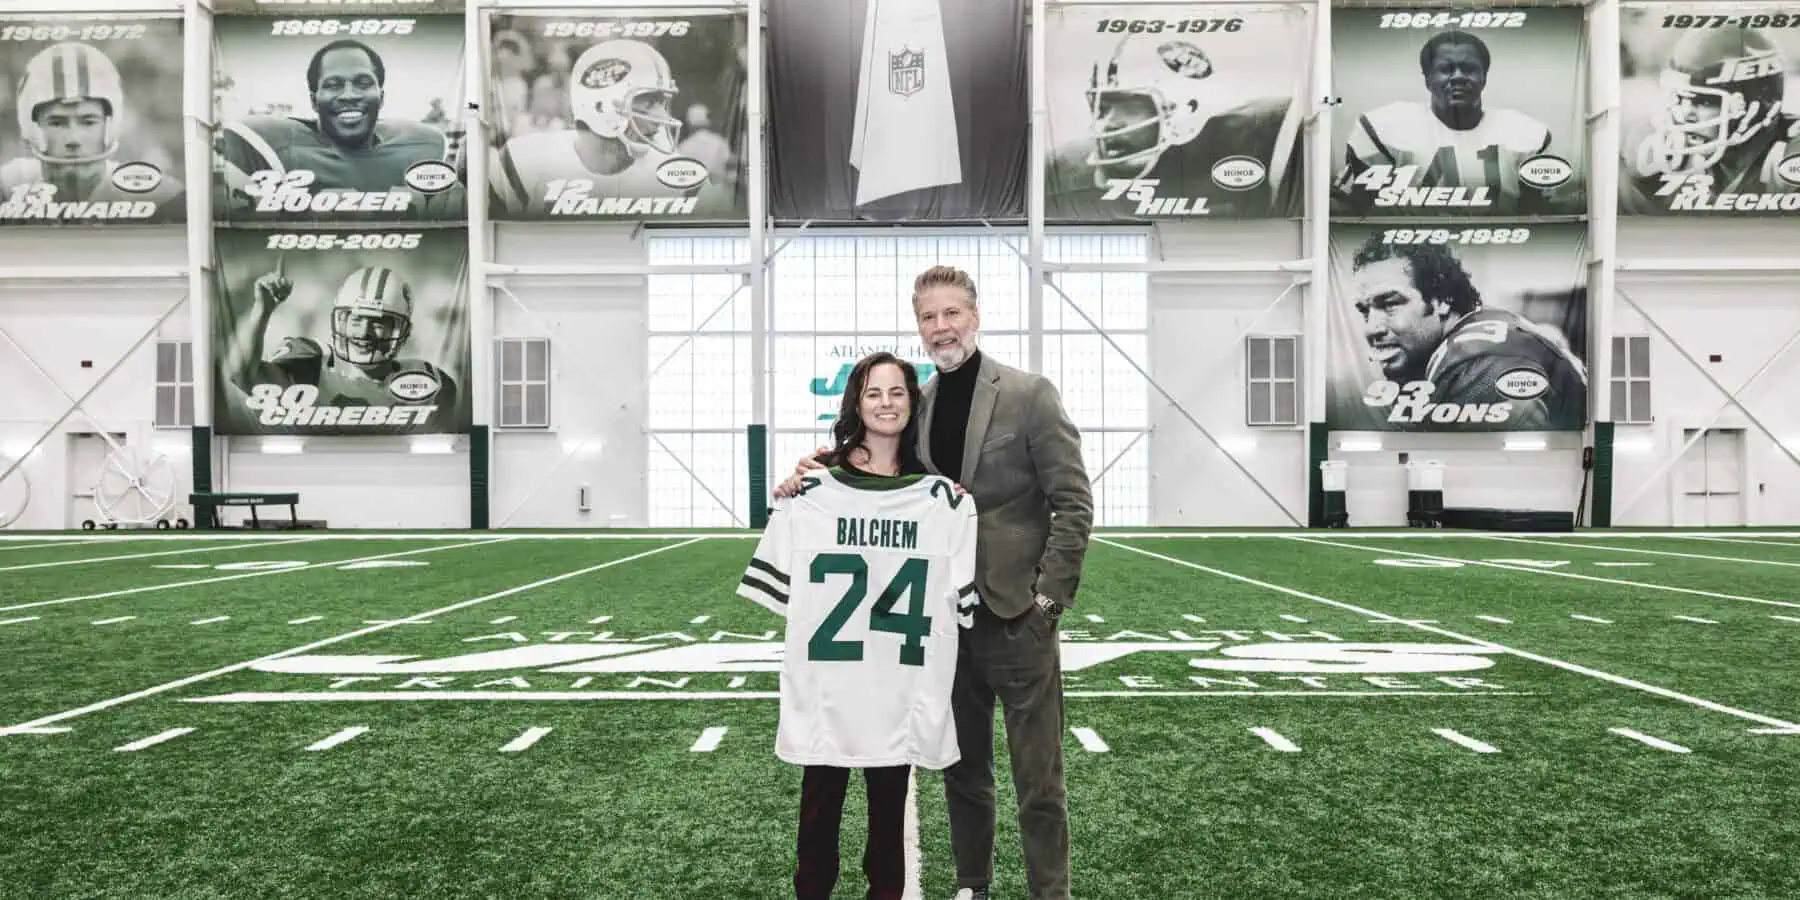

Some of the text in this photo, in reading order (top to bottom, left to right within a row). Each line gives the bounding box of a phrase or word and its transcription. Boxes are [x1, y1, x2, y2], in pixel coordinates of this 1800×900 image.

[271, 19, 416, 35] 1966-1975
[1096, 19, 1243, 33] 1963-1976
[1379, 12, 1527, 28] 1964-1972
[1662, 14, 1800, 28] 1977-1987
[1, 24, 147, 41] 1960-1972
[543, 21, 691, 37] 1965-1976
[892, 69, 922, 93] NFL
[1223, 169, 1254, 177] HONOR
[1355, 164, 1419, 190] 41
[1530, 167, 1561, 175] HONOR
[244, 169, 315, 197] 32
[544, 179, 593, 201] 12
[1101, 178, 1160, 201] 75
[256, 191, 413, 212] BOOZER
[1374, 186, 1492, 206] SNELL
[1669, 193, 1800, 210] KLECKO
[551, 198, 699, 214] NAMATH
[1134, 197, 1210, 215] HILL
[266, 233, 423, 250] 1995-2005
[1382, 228, 1531, 244] 1979-1989
[1507, 380, 1538, 388] HONOR
[246, 384, 319, 409] 80
[1363, 380, 1436, 407] 93
[260, 405, 438, 425] CHREBET
[1387, 402, 1513, 423] LYONS
[836, 517, 919, 549] BALCHEM
[808, 553, 932, 666] 24
[462, 630, 1344, 642] ATLAN EALTH
[329, 676, 747, 688] TRAINI
